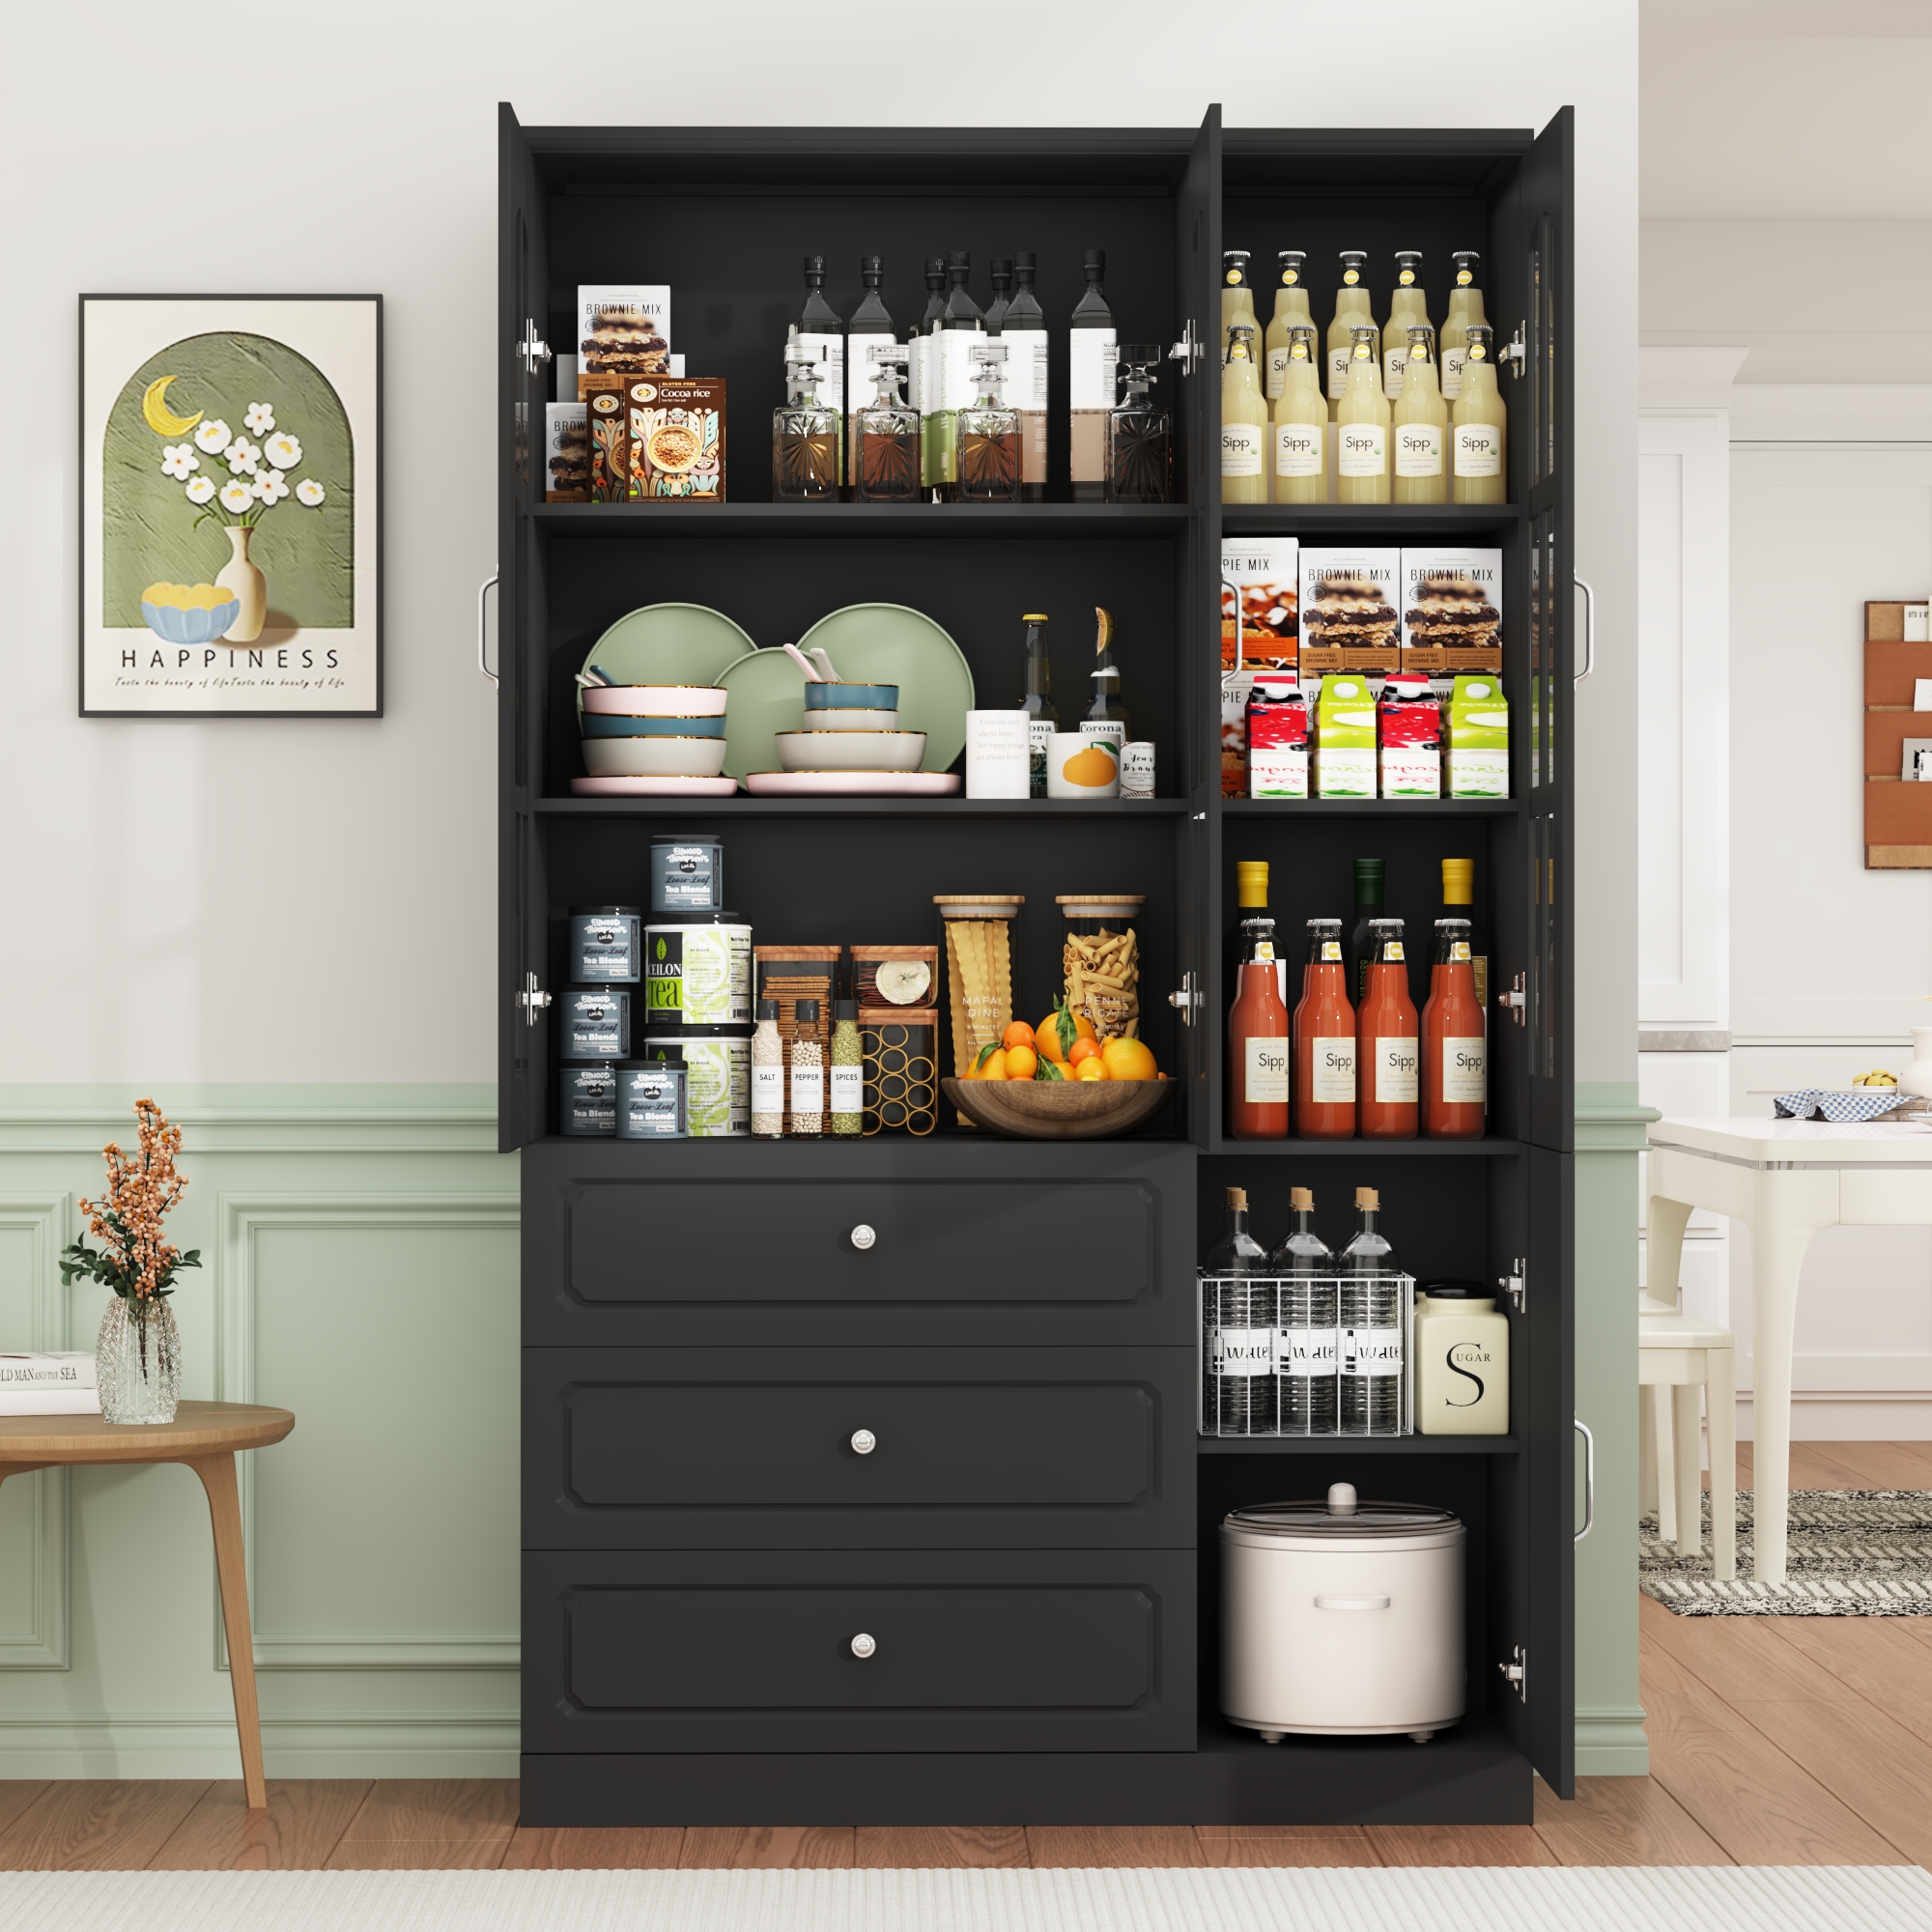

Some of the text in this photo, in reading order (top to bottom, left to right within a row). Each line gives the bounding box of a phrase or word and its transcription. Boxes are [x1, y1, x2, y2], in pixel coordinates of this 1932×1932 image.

[586, 303, 662, 315] BROWNIE MIX
[661, 388, 692, 398] Cocoa
[693, 388, 711, 398] rice
[554, 420, 586, 432] BROW
[940, 412, 949, 430] Oil
[1222, 436, 1250, 452] Sipp
[1283, 436, 1311, 452] Sipp
[1346, 436, 1374, 452] Sipp
[1403, 436, 1431, 452] Sipp
[1462, 436, 1490, 452] Sipp
[1222, 558, 1269, 571] PIE MIX
[1308, 569, 1391, 581] BROWNIE MIX
[1410, 569, 1493, 581] BROWNIE MIX
[122, 649, 338, 668] HAPPINESS
[1222, 691, 1241, 703] PIE
[988, 741, 1006, 750] happy
[1008, 741, 1025, 750] things
[665, 875, 711, 886] Loose-Leaf
[665, 885, 711, 894] Tea Blends
[582, 946, 629, 956] Loose-Leaf
[962, 996, 1005, 1006] MAFAL
[1085, 996, 1127, 1006] PENNE
[968, 1009, 999, 1017] DINE
[1084, 1009, 1128, 1017] RIGATE
[573, 1022, 618, 1034] Loose-Leaf
[573, 1033, 619, 1041] Tea Blends
[1259, 1052, 1285, 1071] Sipp
[1325, 1052, 1352, 1071] Sipp
[1388, 1052, 1415, 1071] Sipp
[1456, 1052, 1482, 1071] Sipp
[629, 1101, 676, 1112] Loose-Leaf
[629, 1112, 676, 1121] Tea Blends
[0, 1367, 77, 1381] LD MAN AND THE SEA
